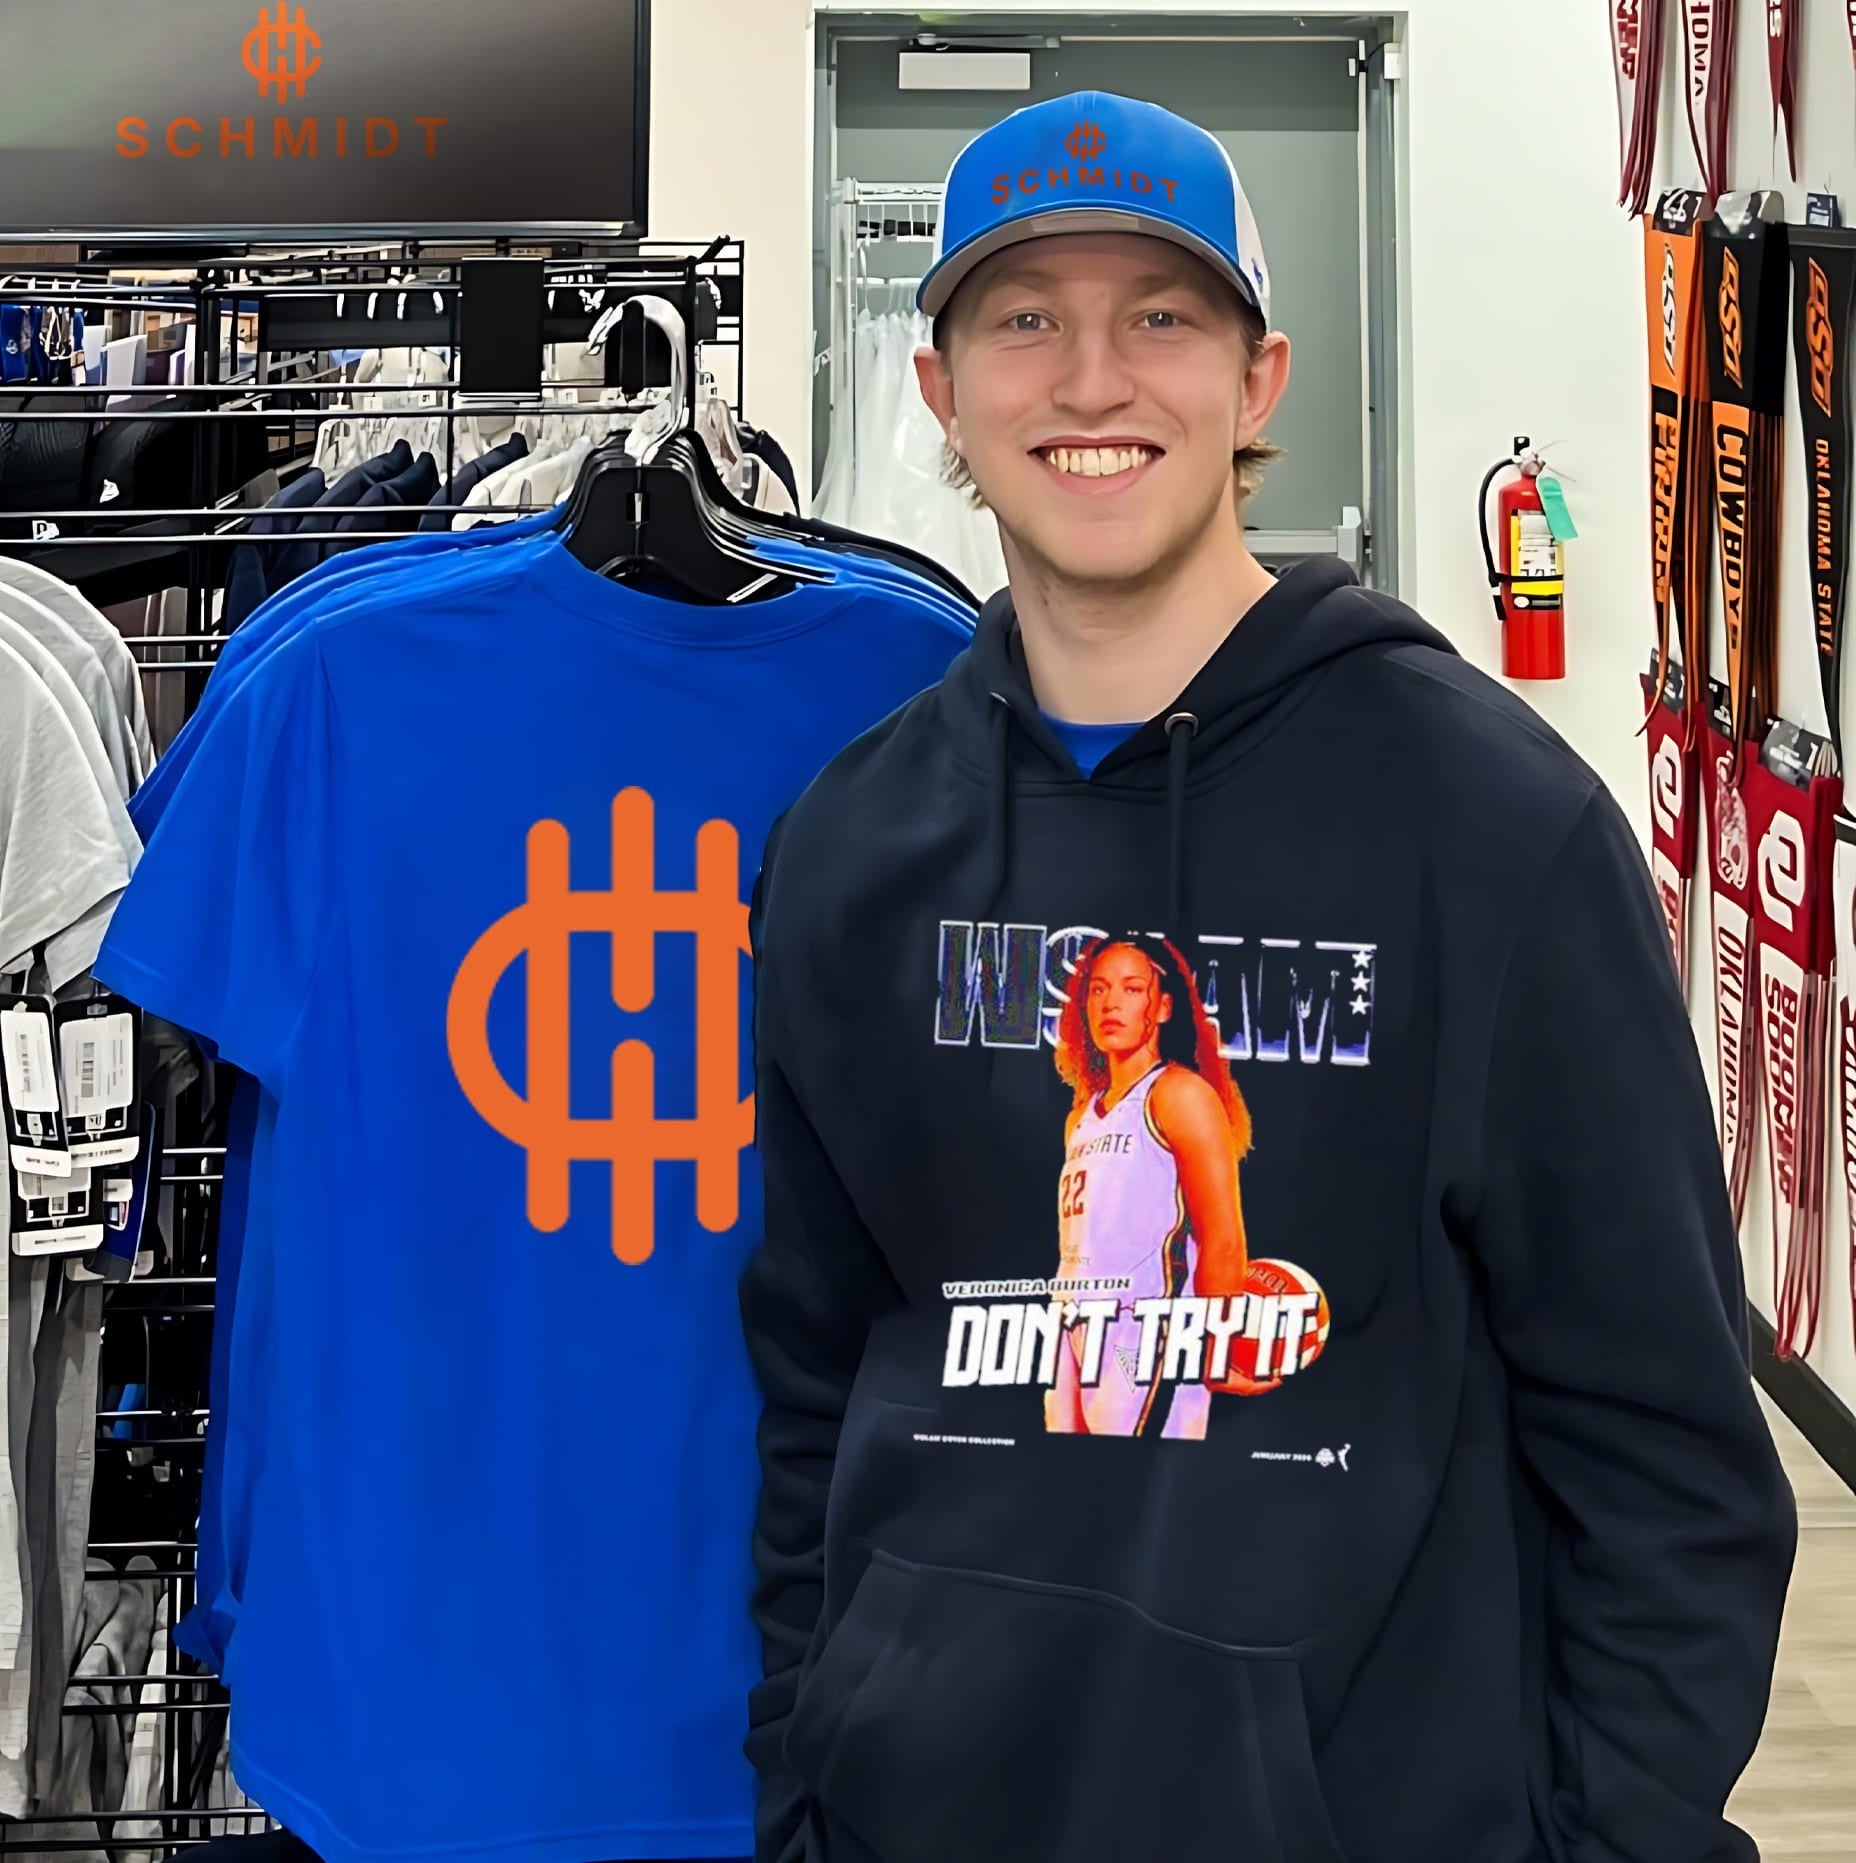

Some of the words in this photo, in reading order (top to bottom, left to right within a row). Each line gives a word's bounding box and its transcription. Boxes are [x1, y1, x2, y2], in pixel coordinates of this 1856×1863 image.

[116, 117, 447, 158] SCHMIDT
[991, 167, 1179, 204] SCHMIDT
[1085, 1133, 1134, 1157] STATE
[1061, 1170, 1087, 1219] 22
[942, 1279, 1047, 1299] VERONICA
[1049, 1277, 1134, 1294] BURTON
[942, 1299, 1120, 1387] DON'T
[1134, 1295, 1248, 1382] TRY
[1255, 1292, 1319, 1377] IT
